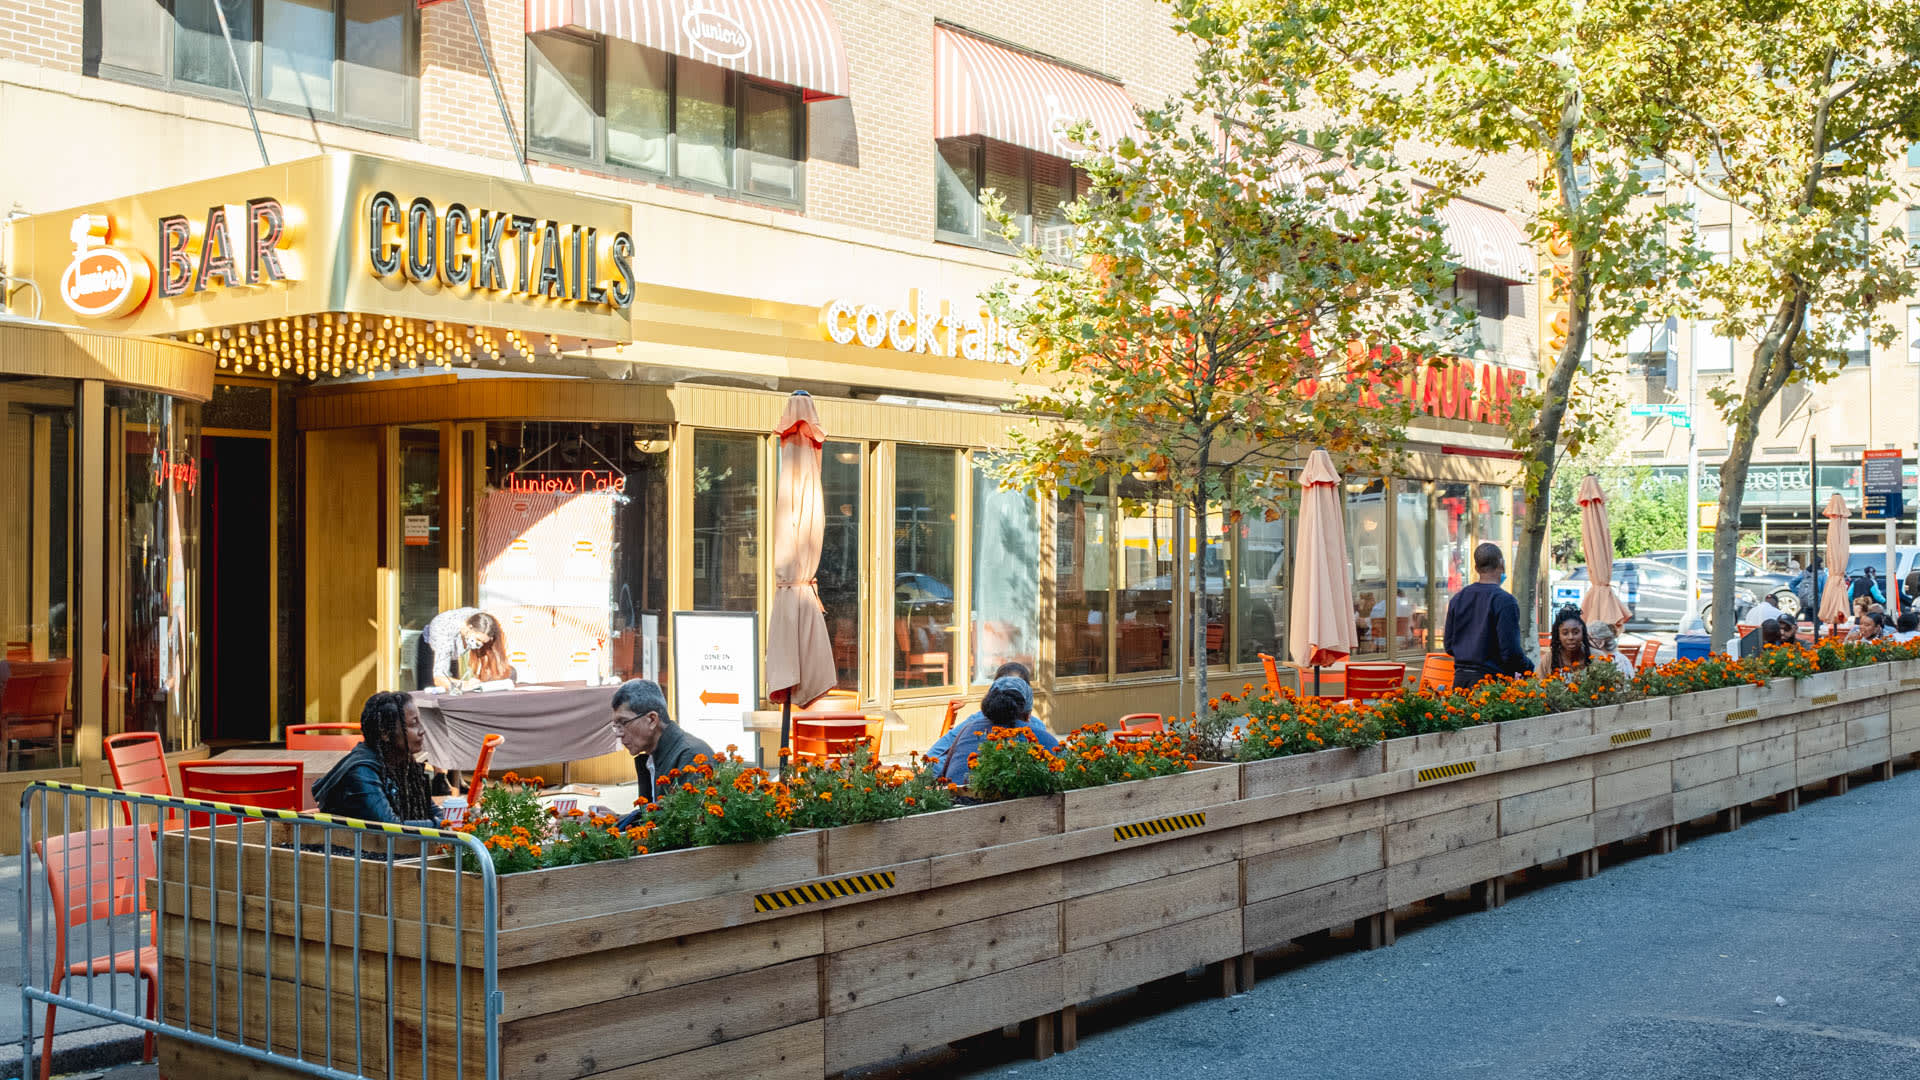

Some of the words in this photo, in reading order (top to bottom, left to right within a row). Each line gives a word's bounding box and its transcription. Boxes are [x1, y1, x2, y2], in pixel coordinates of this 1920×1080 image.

[158, 197, 286, 299] BAR
[369, 190, 636, 309] COCKTAILS
[827, 287, 1029, 367] cocktails
